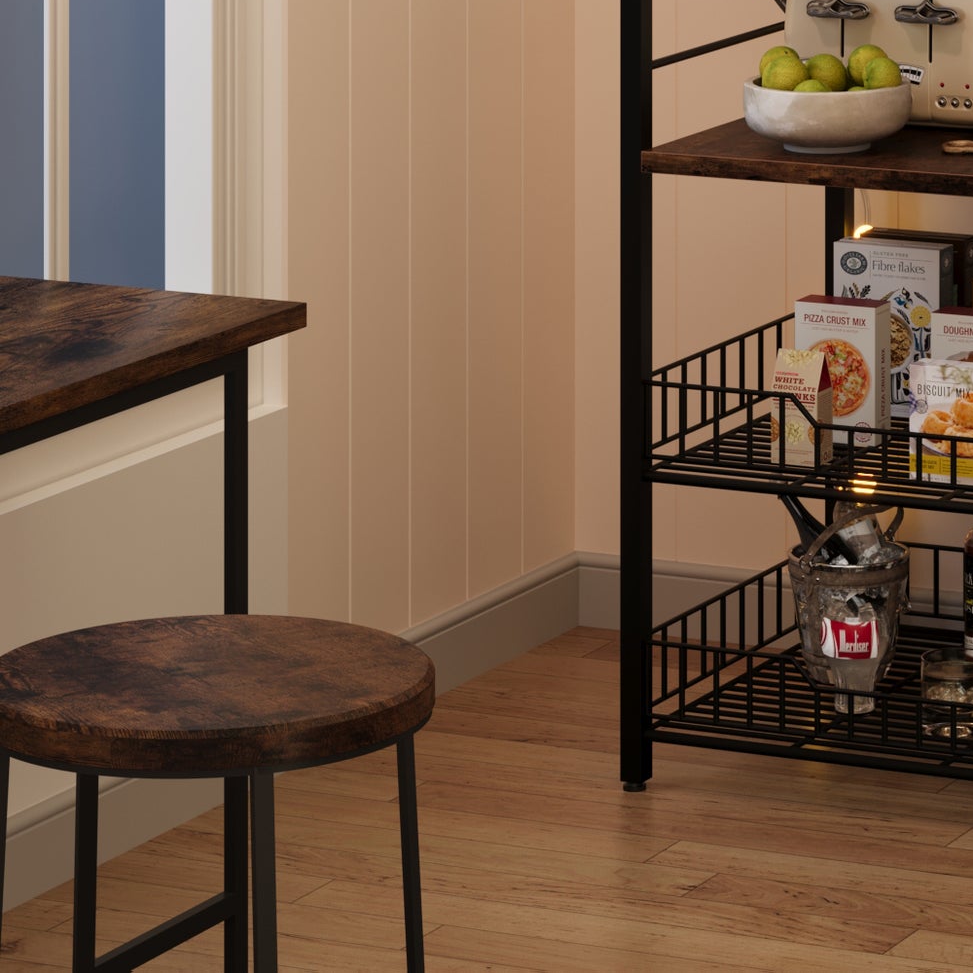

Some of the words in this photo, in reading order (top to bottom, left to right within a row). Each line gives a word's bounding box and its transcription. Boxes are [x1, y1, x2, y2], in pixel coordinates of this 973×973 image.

[872, 260, 896, 272] Fibre
[898, 261, 926, 275] flakes
[803, 313, 825, 323] PIZZA
[826, 315, 850, 325] CRUST
[852, 318, 866, 326] MIX
[774, 376, 805, 385] WHITE
[772, 383, 817, 393] CHOCOLATE
[917, 383, 951, 397] BISCUIT
[955, 387, 971, 399] MIX
